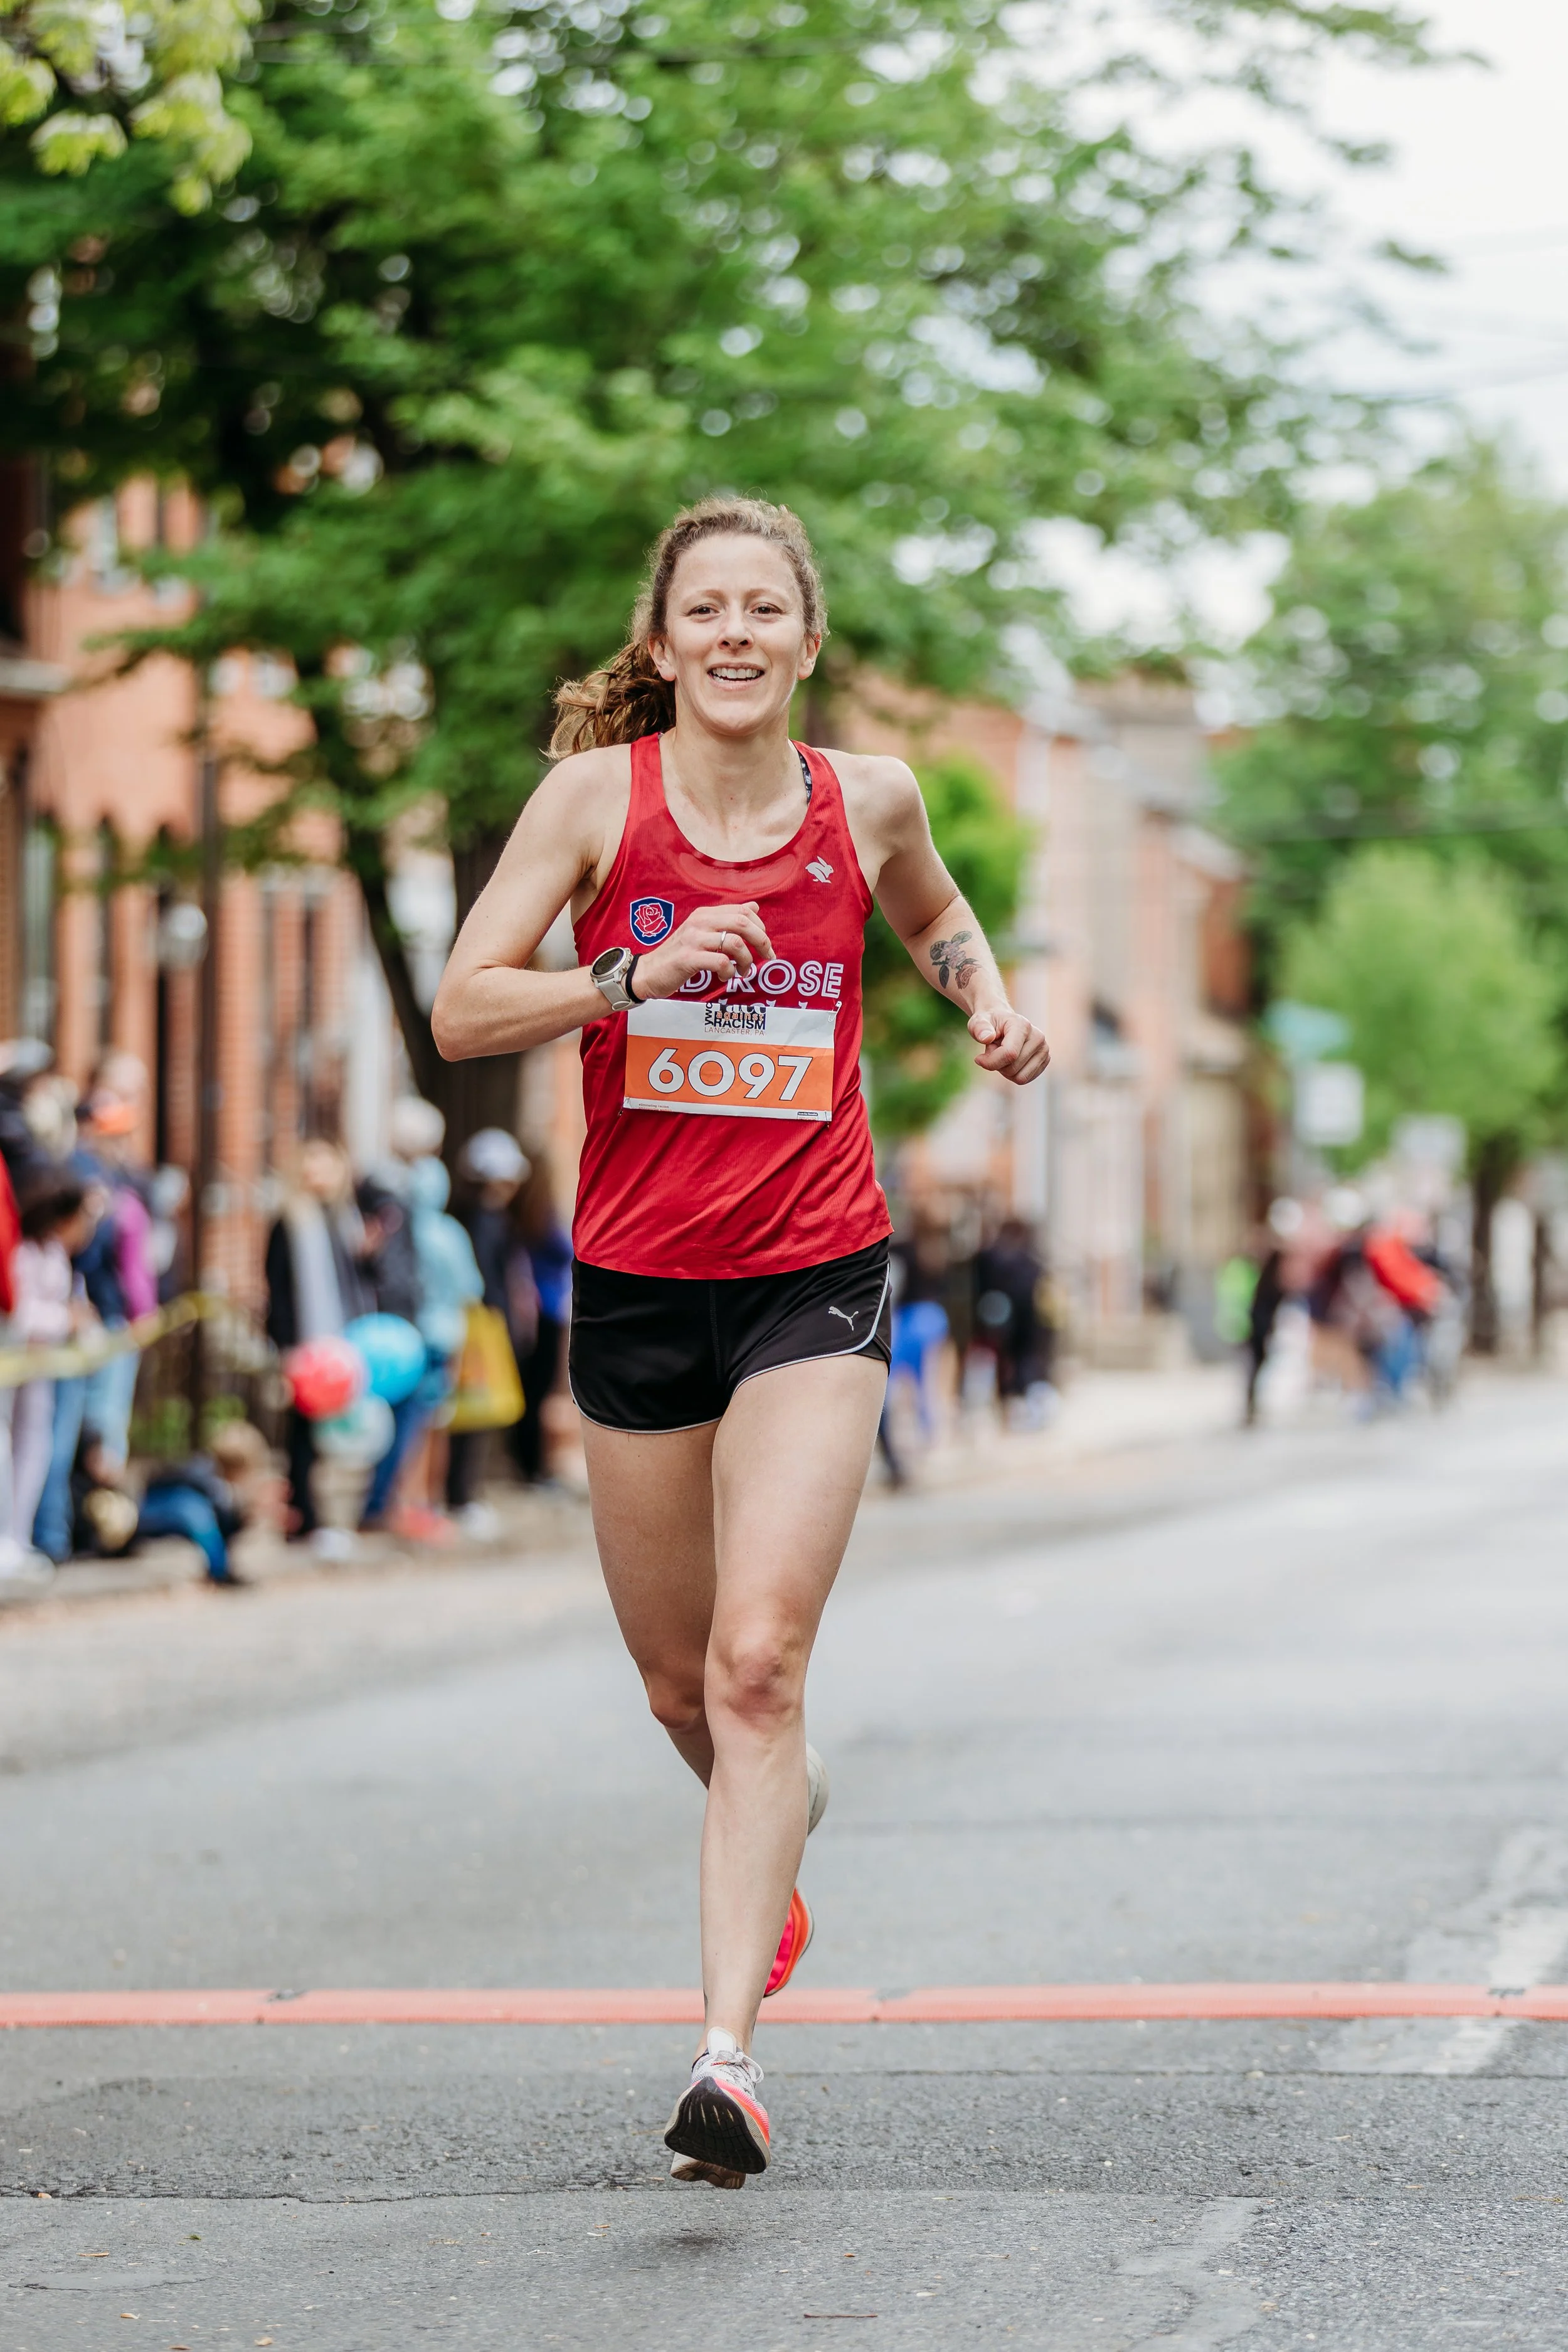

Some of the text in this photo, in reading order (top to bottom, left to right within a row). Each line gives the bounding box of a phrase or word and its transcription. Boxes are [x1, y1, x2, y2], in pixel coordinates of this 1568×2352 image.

[726, 959, 844, 999] ROSE
[714, 1015, 766, 1030] RACISM
[716, 1010, 764, 1021] against
[648, 1048, 813, 1101] 6097
